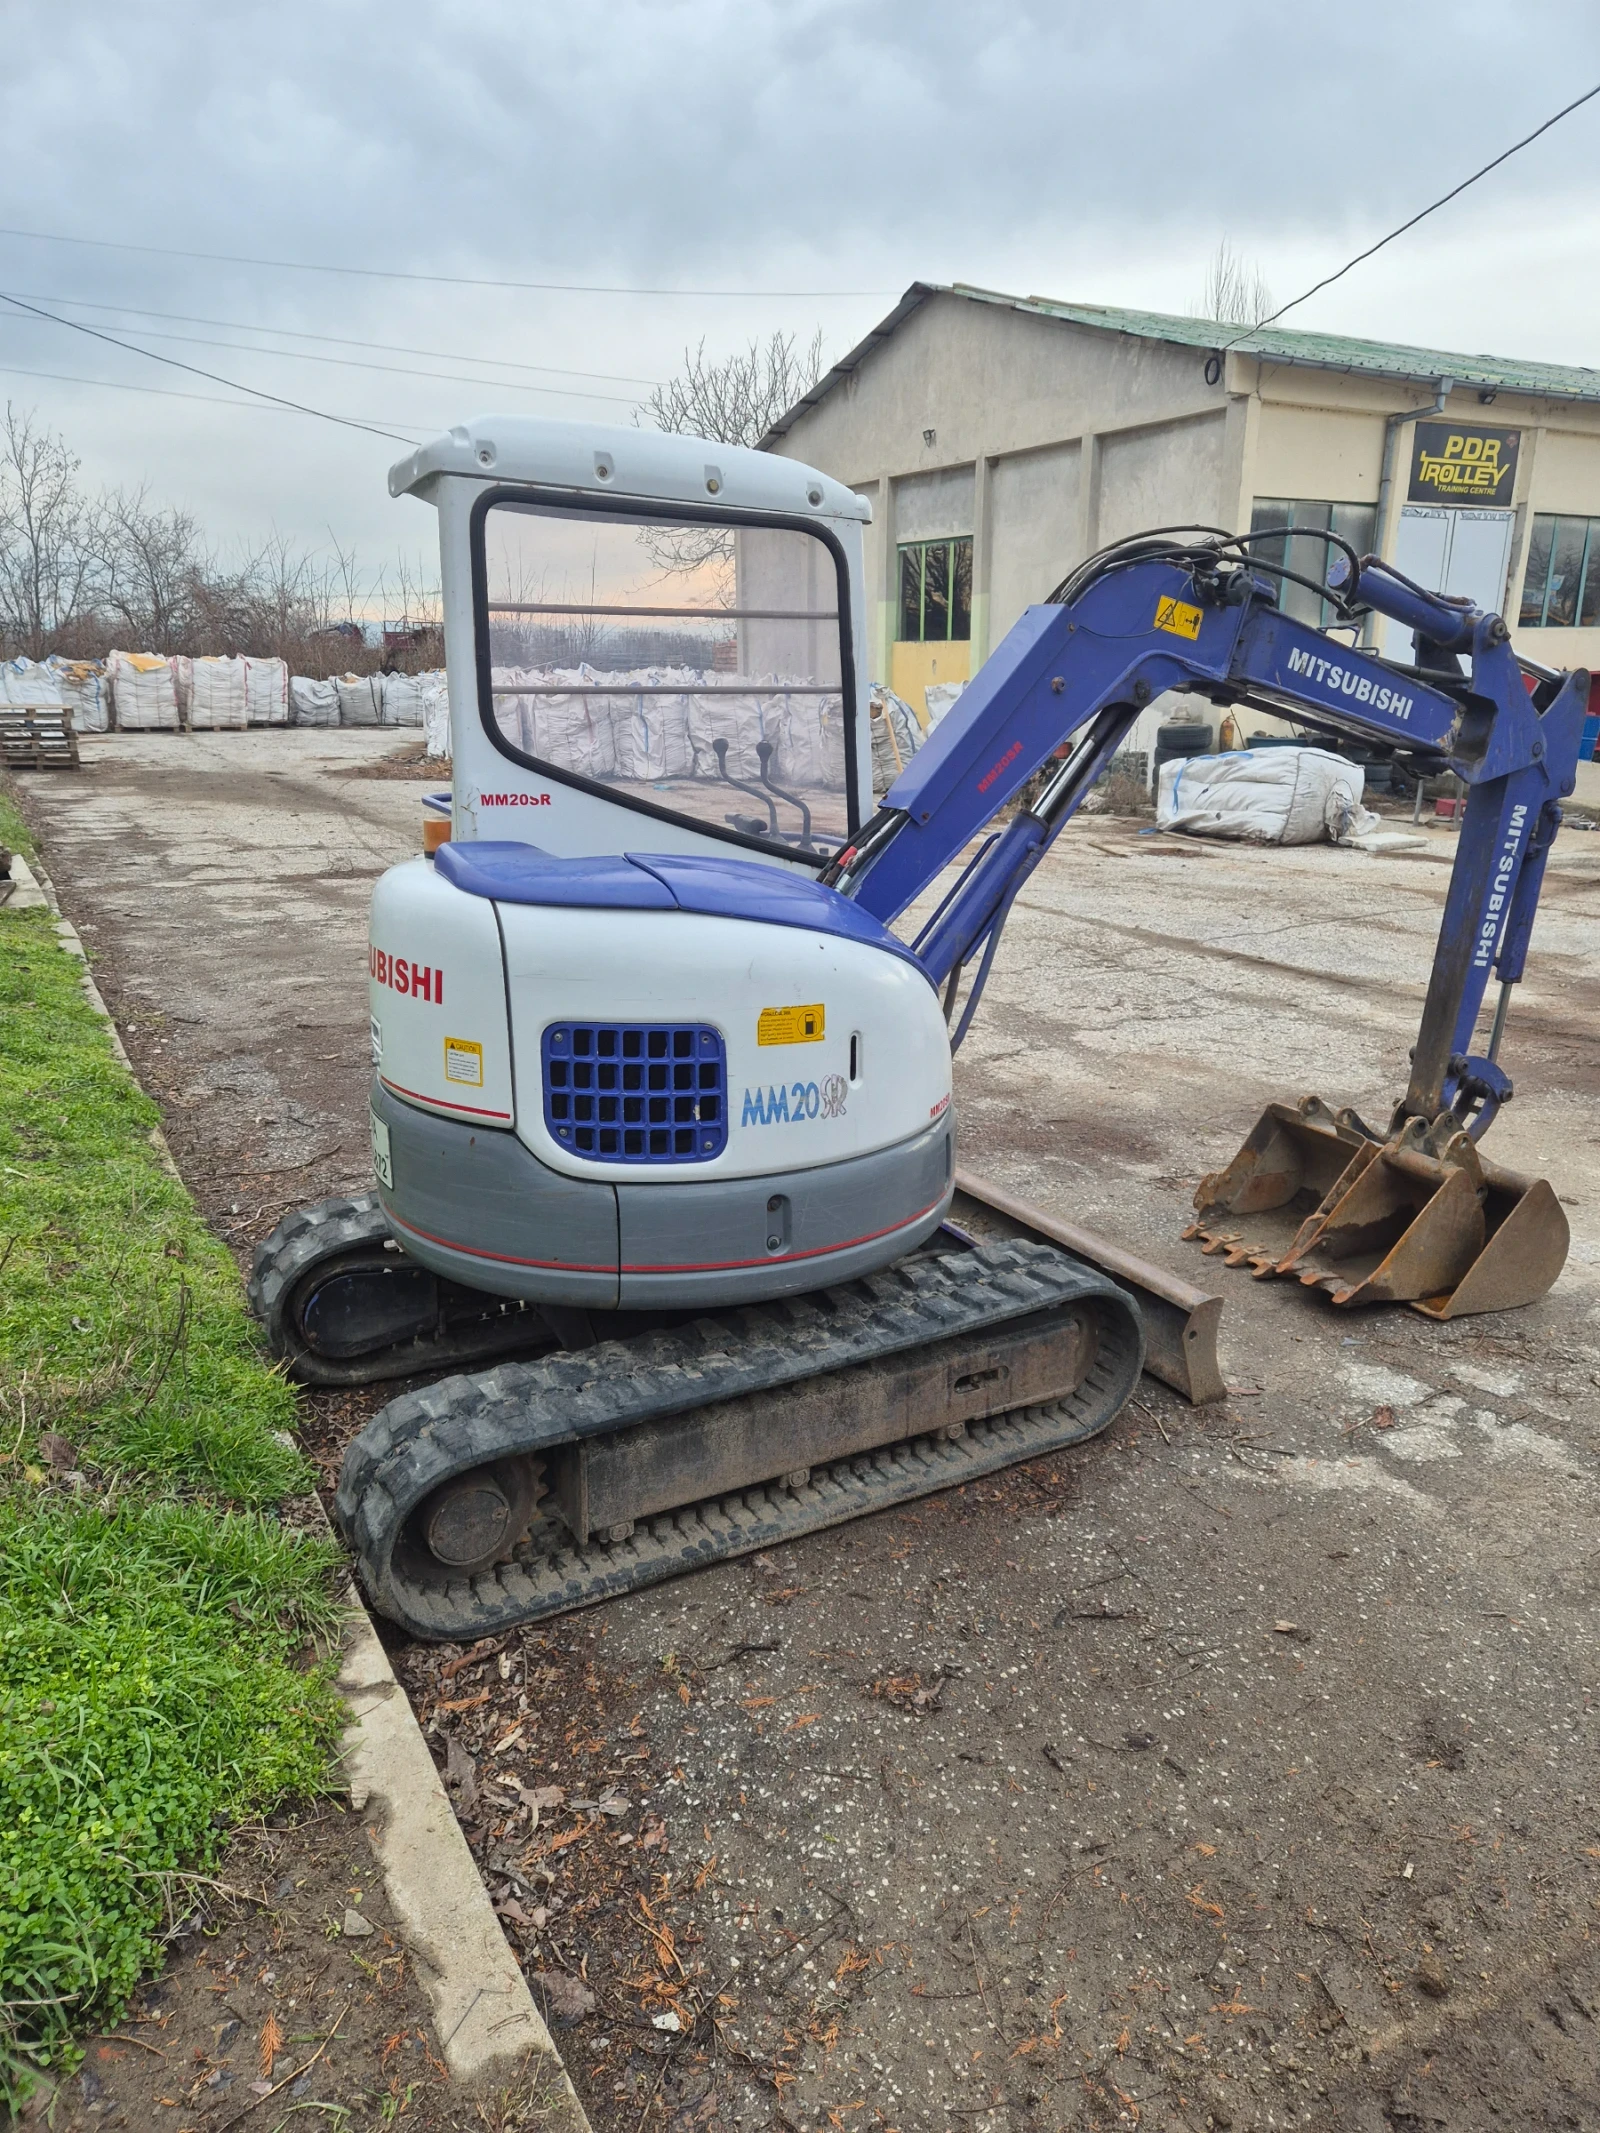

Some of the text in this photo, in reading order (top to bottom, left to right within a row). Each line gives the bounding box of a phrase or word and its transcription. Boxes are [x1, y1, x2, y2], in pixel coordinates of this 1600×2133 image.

[1419, 450, 1510, 486] TROLLEY
[1444, 435, 1501, 467] PDR
[1438, 484, 1497, 496] TRAINING CENTRE
[1287, 647, 1414, 720] MITSUBISHI
[1473, 804, 1528, 968] MITSUBISHI
